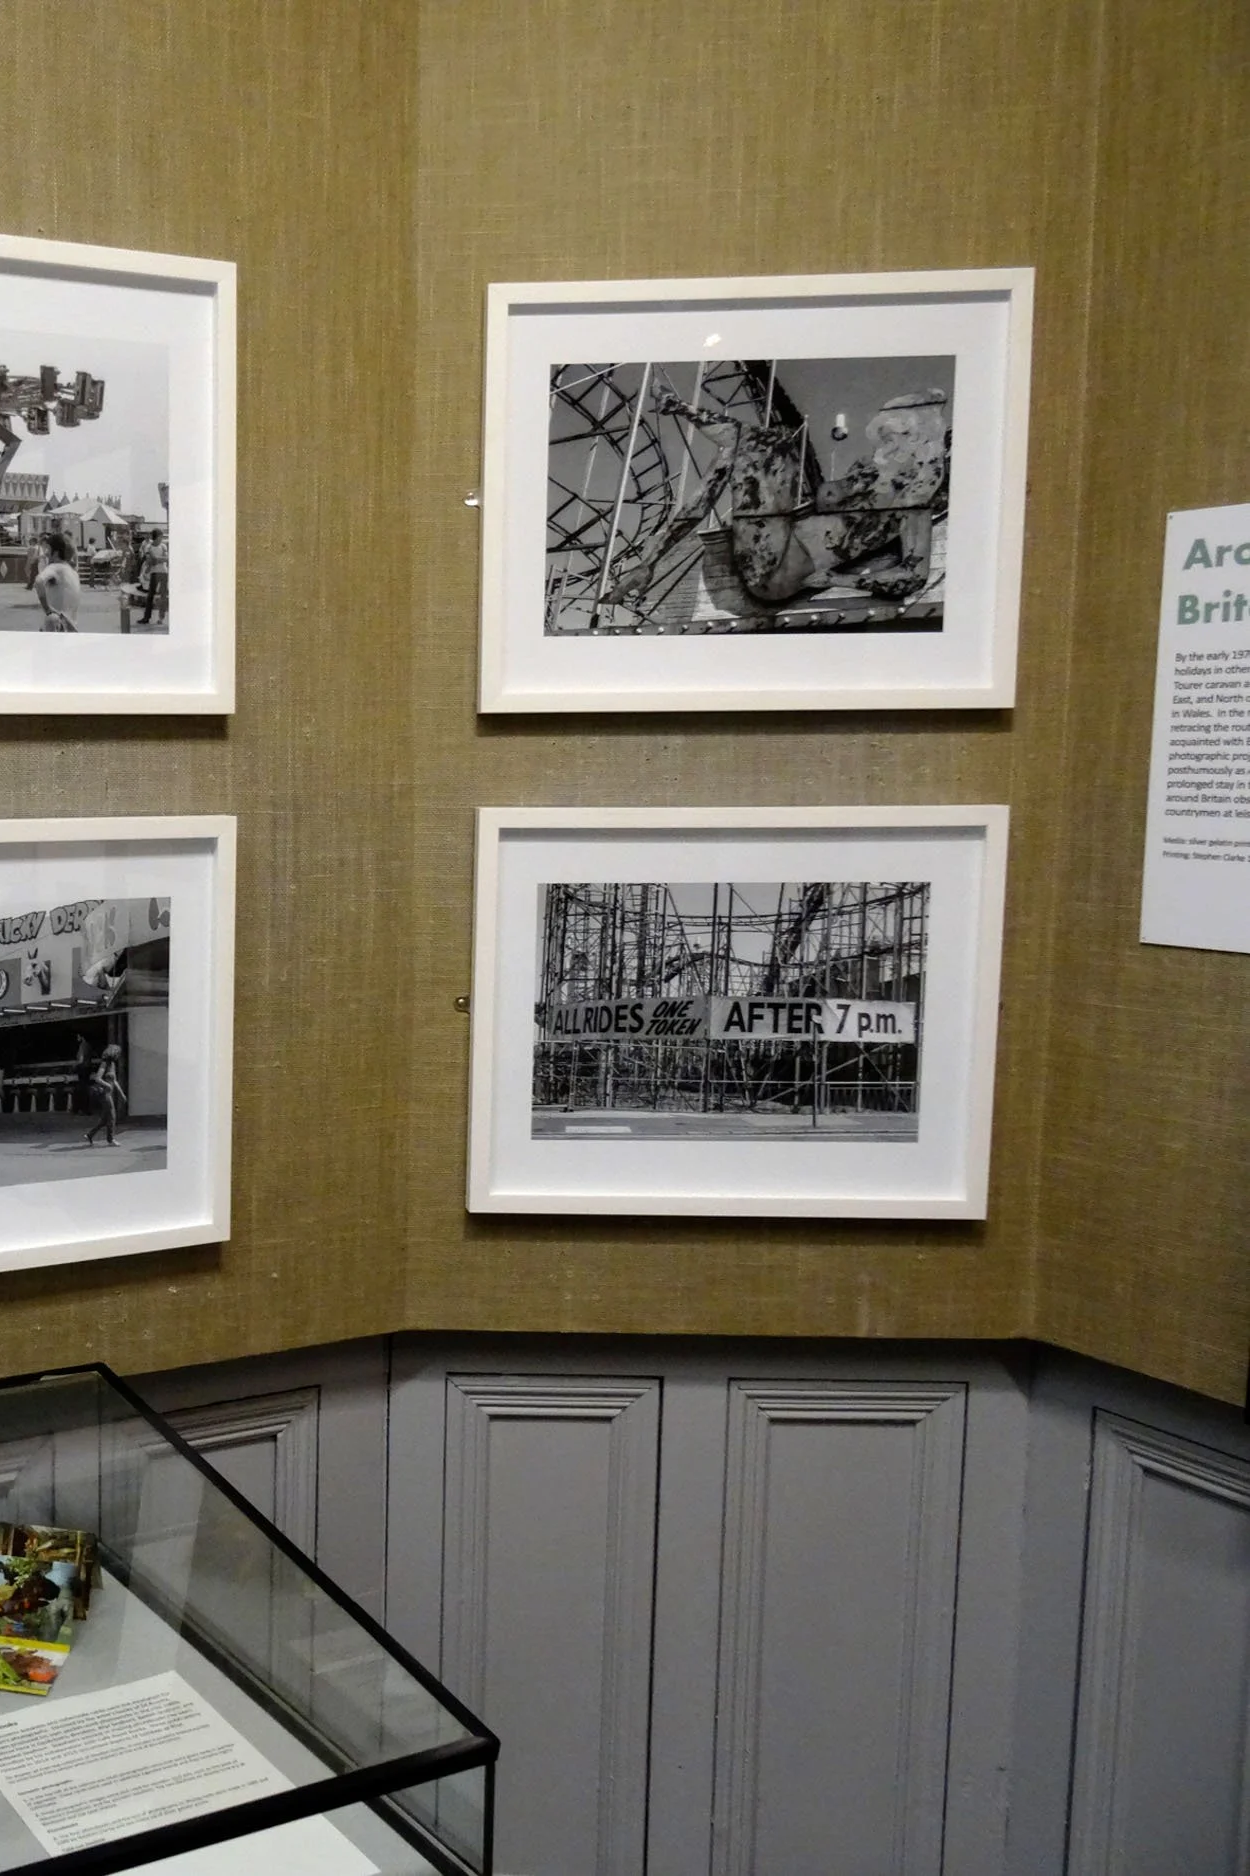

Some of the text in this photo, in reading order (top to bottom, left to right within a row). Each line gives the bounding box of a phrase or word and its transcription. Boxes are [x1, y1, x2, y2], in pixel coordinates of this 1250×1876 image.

[1177, 589, 1250, 625] Brit
[1175, 653, 1187, 663] By
[1189, 651, 1204, 661] the
[1206, 650, 1229, 661] early
[1174, 667, 1212, 676] holidays
[1214, 667, 1223, 675] in
[1174, 681, 1203, 690] Tourer
[1205, 681, 1241, 689] caravan
[1196, 695, 1213, 704] and
[1216, 693, 1243, 703] North
[1171, 709, 1180, 718] in
[1182, 709, 1213, 718] Wales.
[1228, 709, 1245, 718] the
[1170, 723, 1211, 734] retracing
[1213, 722, 1229, 732] the
[1169, 737, 1221, 748] acquainted
[1223, 736, 1244, 746] with
[1168, 751, 1231, 762] photographic
[1167, 765, 1233, 777] posthumously
[1166, 779, 1214, 791] prolonged
[1215, 781, 1235, 791] stay
[1236, 780, 1246, 789] in
[1166, 794, 1199, 802] around
[1201, 793, 1232, 803] Britain
[1164, 808, 1221, 818] countrymen
[1223, 809, 1232, 818] at
[50, 900, 104, 935] DER
[652, 1000, 695, 1018] ONE
[553, 1003, 645, 1035] ALL RIDES
[723, 1001, 902, 1038] AFTER 7 p.m.
[645, 1018, 702, 1036] TOKEN
